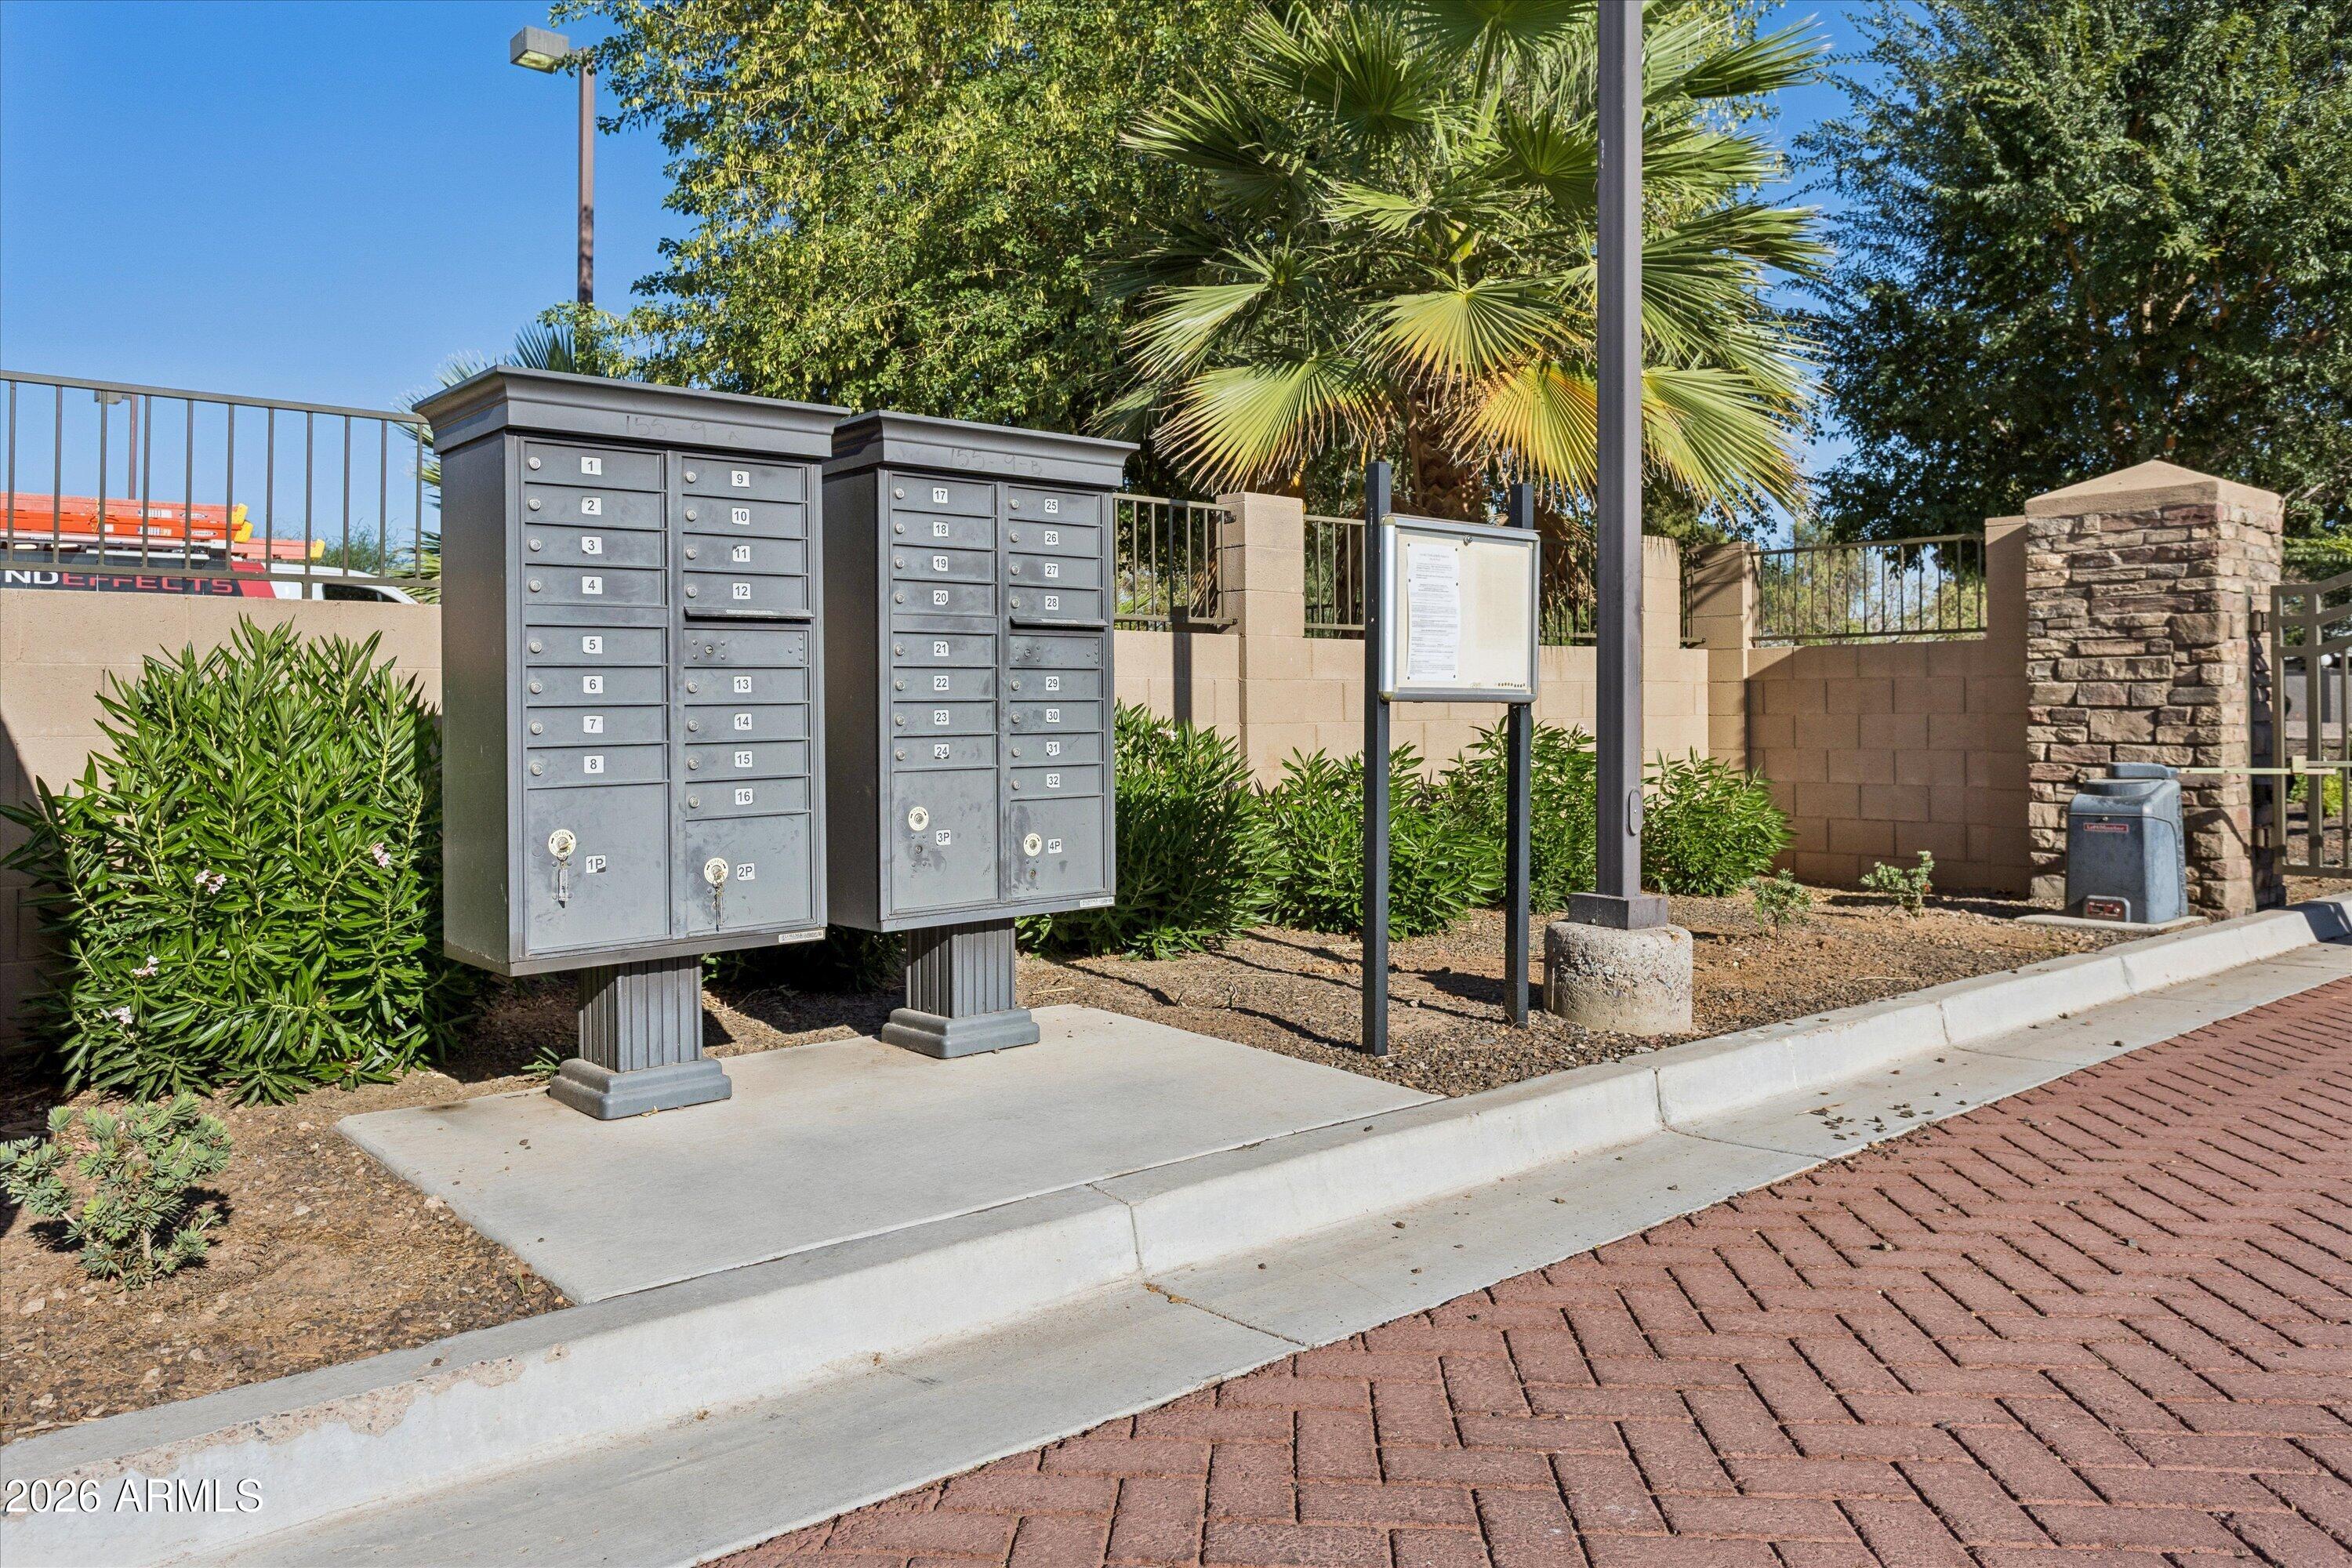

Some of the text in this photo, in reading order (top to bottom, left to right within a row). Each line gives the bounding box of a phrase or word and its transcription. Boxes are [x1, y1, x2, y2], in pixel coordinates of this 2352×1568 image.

[587, 460, 593, 471] 1
[736, 474, 743, 485] 9
[935, 490, 946, 500] 17
[587, 499, 595, 511] 2
[1046, 500, 1057, 510] 25
[734, 510, 747, 522] 10
[935, 524, 948, 535] 18
[1046, 532, 1057, 543] 26
[588, 539, 595, 551] 3
[735, 548, 746, 559] 11
[935, 558, 946, 568] 19
[1047, 565, 1057, 575] 27
[588, 579, 597, 590] 4
[735, 585, 748, 597] 12
[935, 592, 947, 603] 20
[1047, 597, 1058, 608] 28
[589, 639, 596, 651] 5
[935, 644, 946, 654] 21
[589, 678, 597, 690] 6
[736, 679, 750, 690] 13
[935, 677, 947, 688] 22
[1047, 678, 1058, 688] 29
[935, 712, 947, 722] 23
[1048, 710, 1058, 720] 30
[589, 718, 597, 730] 7
[736, 716, 750, 727] 14
[936, 746, 948, 757] 24
[1048, 743, 1058, 753] 31
[590, 758, 597, 770] 8
[737, 753, 750, 764] 15
[1048, 775, 1058, 786] 32
[738, 791, 751, 802] 16
[938, 832, 950, 843] 3P
[1049, 840, 1061, 851] 4P
[587, 858, 604, 870] 1P
[738, 866, 753, 878] 2P
